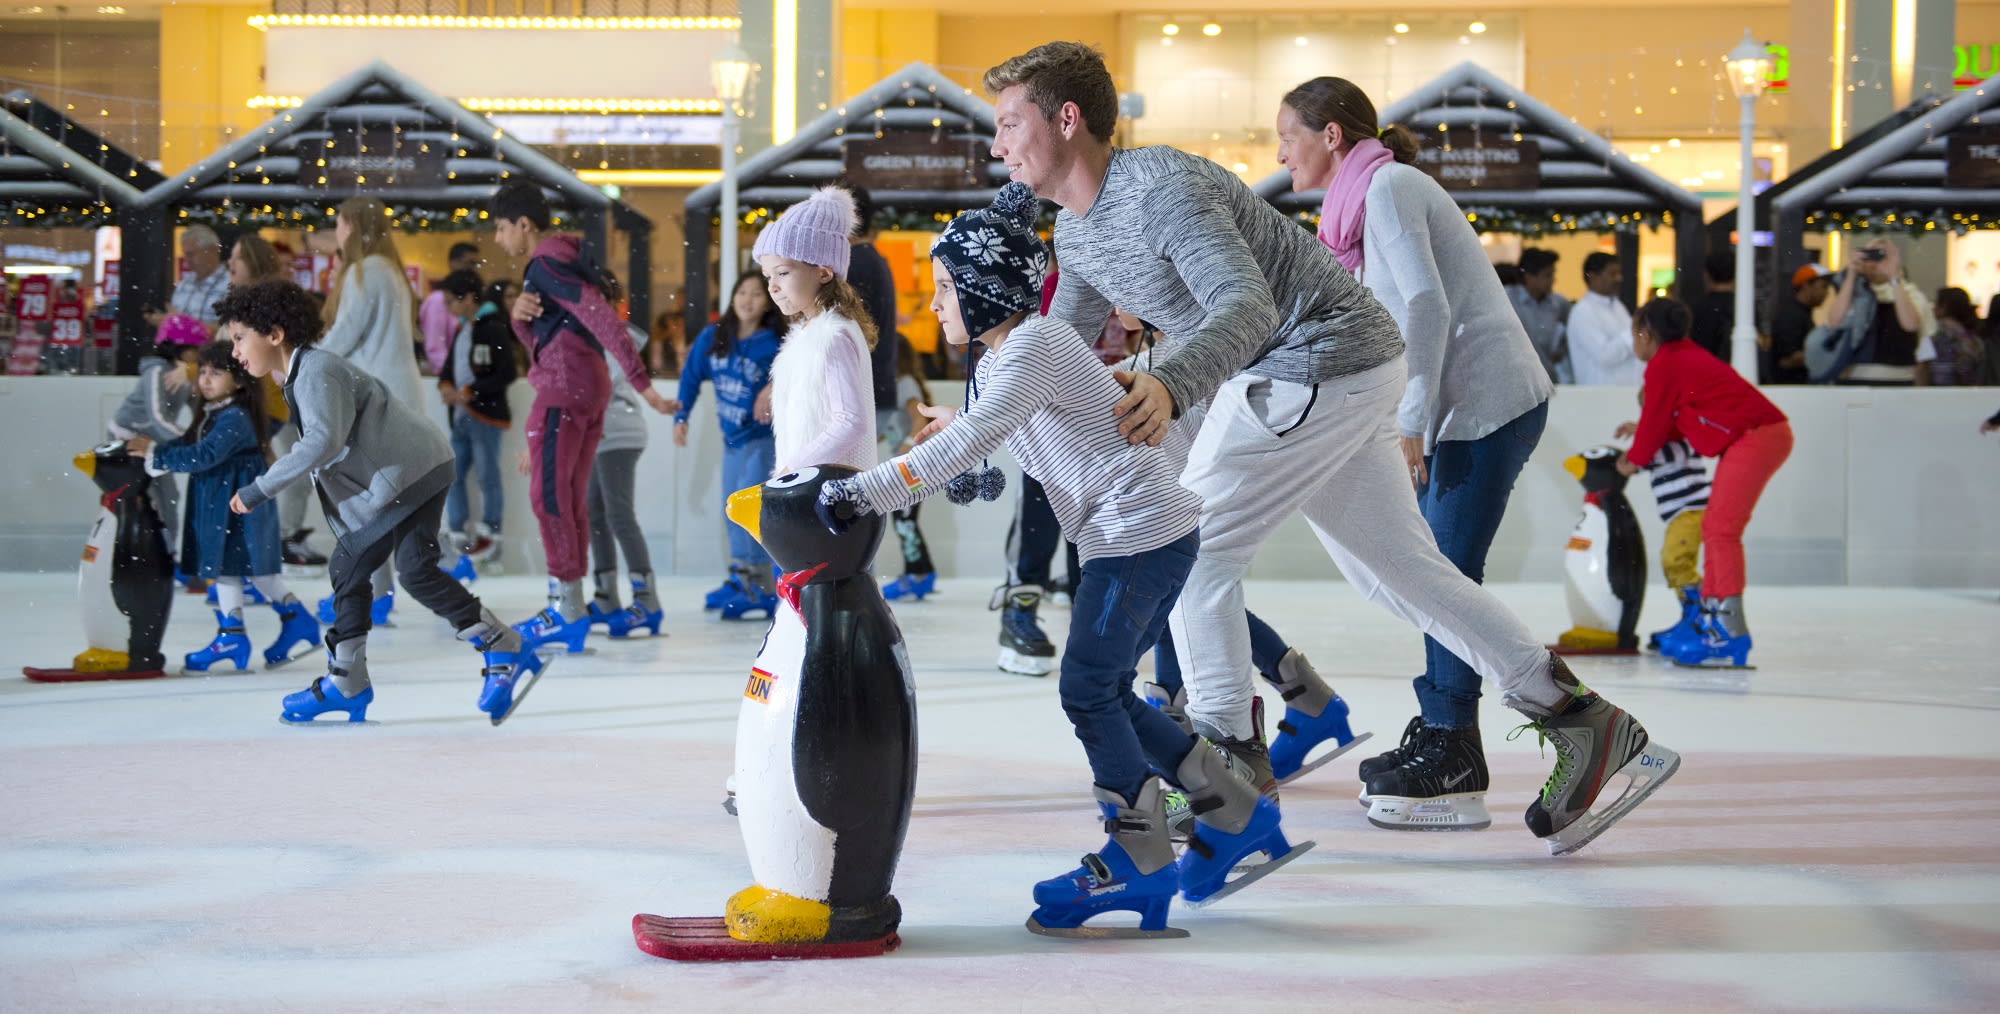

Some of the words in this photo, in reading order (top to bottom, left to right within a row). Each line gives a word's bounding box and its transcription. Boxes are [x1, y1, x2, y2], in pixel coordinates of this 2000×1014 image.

[863, 155, 913, 170] GREEN
[1441, 149, 1520, 163] INVENTING
[1441, 165, 1487, 179] ROOM
[21, 294, 47, 317] 79
[53, 318, 82, 341] 39
